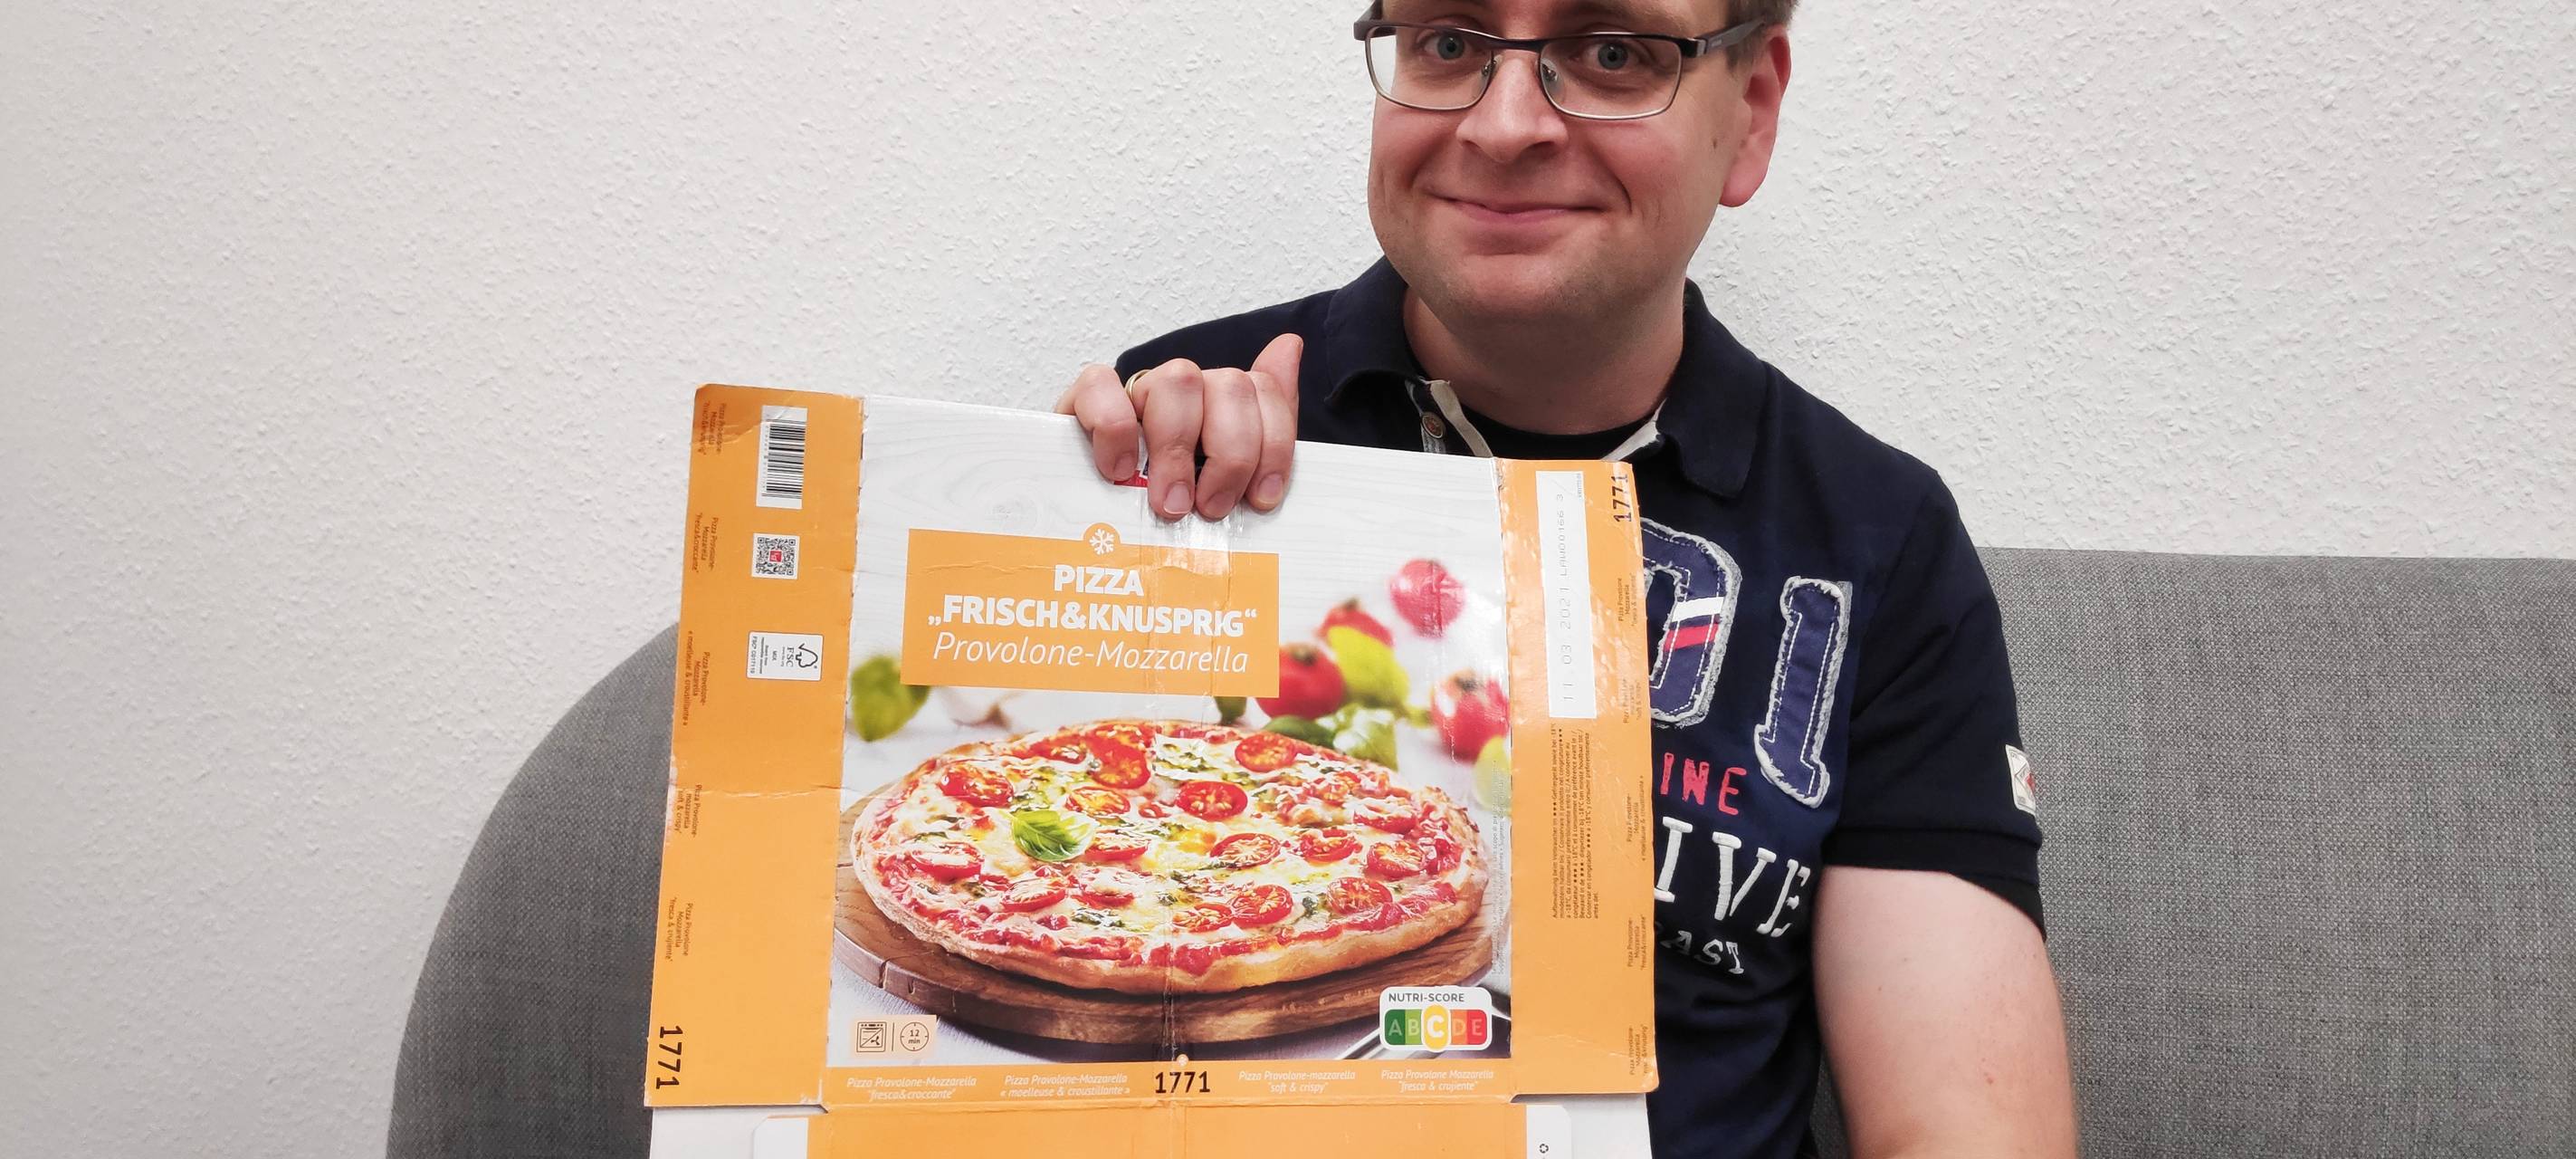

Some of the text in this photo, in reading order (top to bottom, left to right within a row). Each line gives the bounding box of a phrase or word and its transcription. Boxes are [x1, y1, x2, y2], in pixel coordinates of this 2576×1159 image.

[1610, 474, 1632, 522] 1771
[1054, 564, 1144, 596] PIZZA
[702, 652, 711, 668] Pizza
[786, 647, 795, 667] FSC
[933, 632, 1248, 674] Provolone-Mozzarella
[1660, 752, 1748, 816] INE
[1654, 816, 1811, 938] IVE
[685, 903, 693, 920] Pizza
[1655, 921, 1745, 974] AST
[1388, 992, 1465, 1003] NUTRI-SCORE
[909, 1029, 920, 1038] 12
[655, 1025, 683, 1089] 1771
[847, 1076, 977, 1087] Pizza Provolone-Mozzarella
[1005, 1073, 1128, 1086] Pizza Provolone-Mozzarella
[1154, 1071, 1211, 1094] 1771
[1238, 1070, 1356, 1081] Pizza Provolone-mozzarella
[1381, 1069, 1493, 1080] Pizza Provolone Mozzarella
[1009, 1087, 1054, 1097] moelleuse
[1057, 1087, 1065, 1096] &
[1068, 1086, 1122, 1097] croustillante
[1289, 1083, 1297, 1092] &
[1428, 1081, 1436, 1091] &
